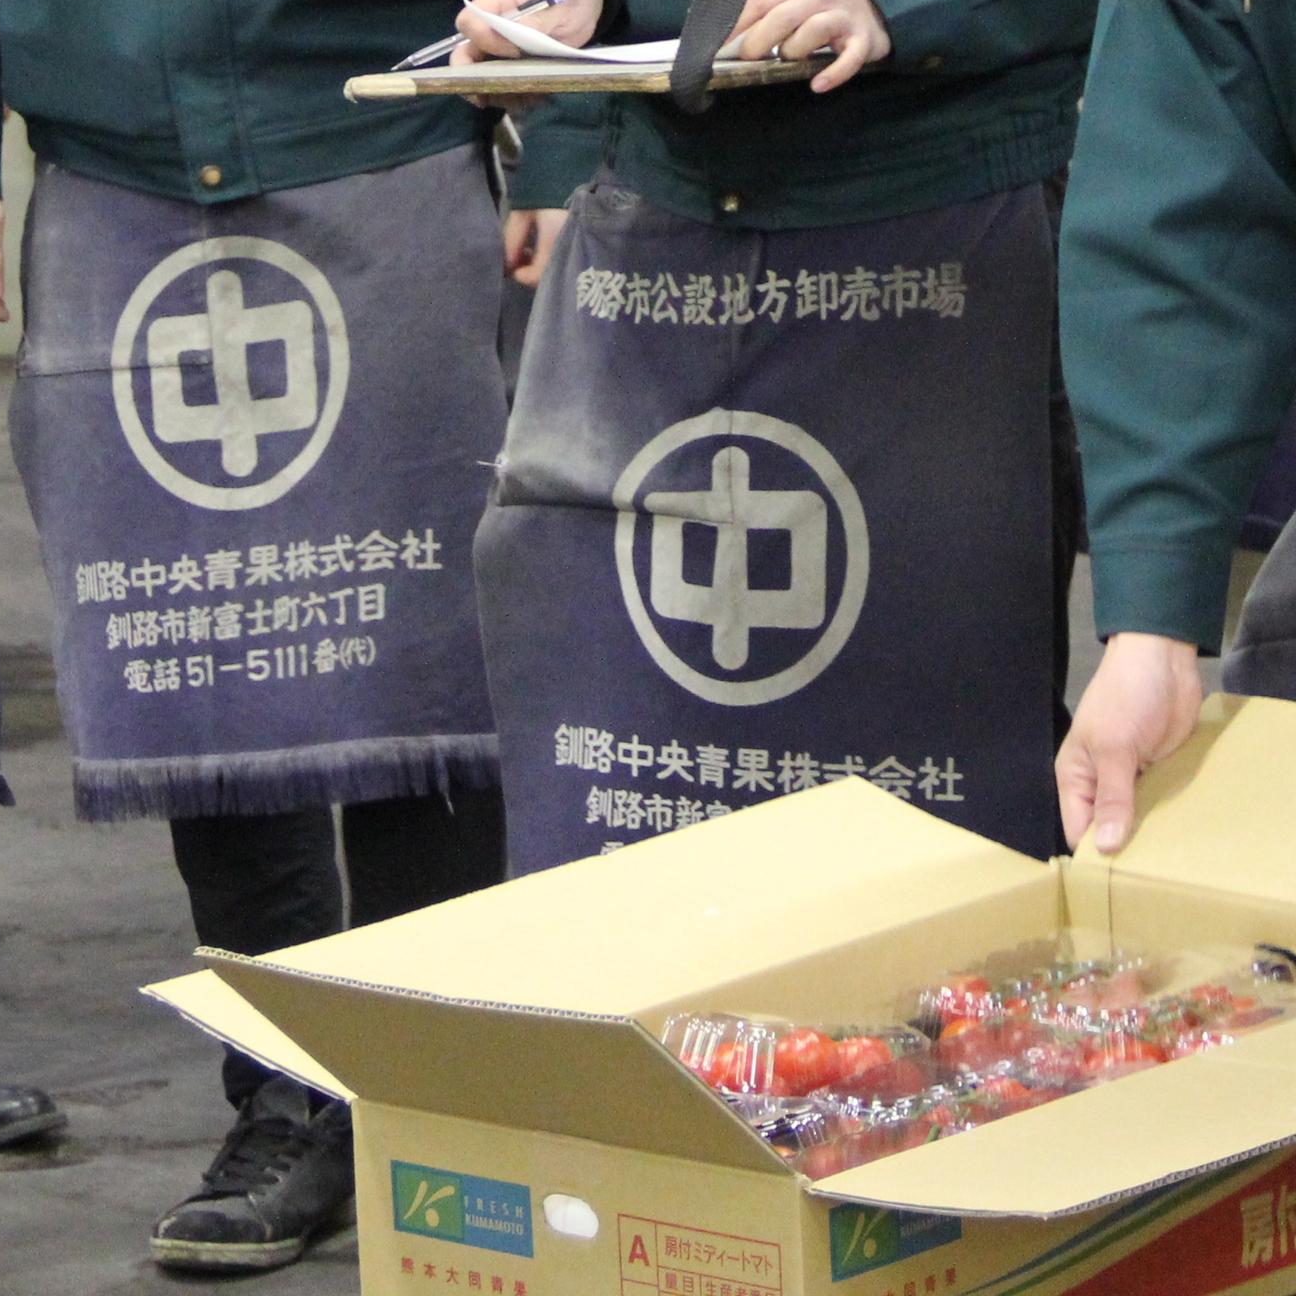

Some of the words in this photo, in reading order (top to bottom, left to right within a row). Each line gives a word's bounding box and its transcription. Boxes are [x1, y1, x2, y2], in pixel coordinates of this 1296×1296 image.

[575, 262, 968, 325] 釧路市公設地方卸売市場
[147, 269, 317, 477] 中
[76, 529, 442, 604] 釧路中央青果株式会社
[643, 445, 827, 671] 中
[105, 584, 387, 649] 釧路市新富士町六丁目
[464, 1195, 525, 1219] FRESH
[465, 1212, 525, 1236] KUMAMOTO
[627, 1234, 650, 1267] A
[664, 1234, 774, 1277] 房付ミディートマト
